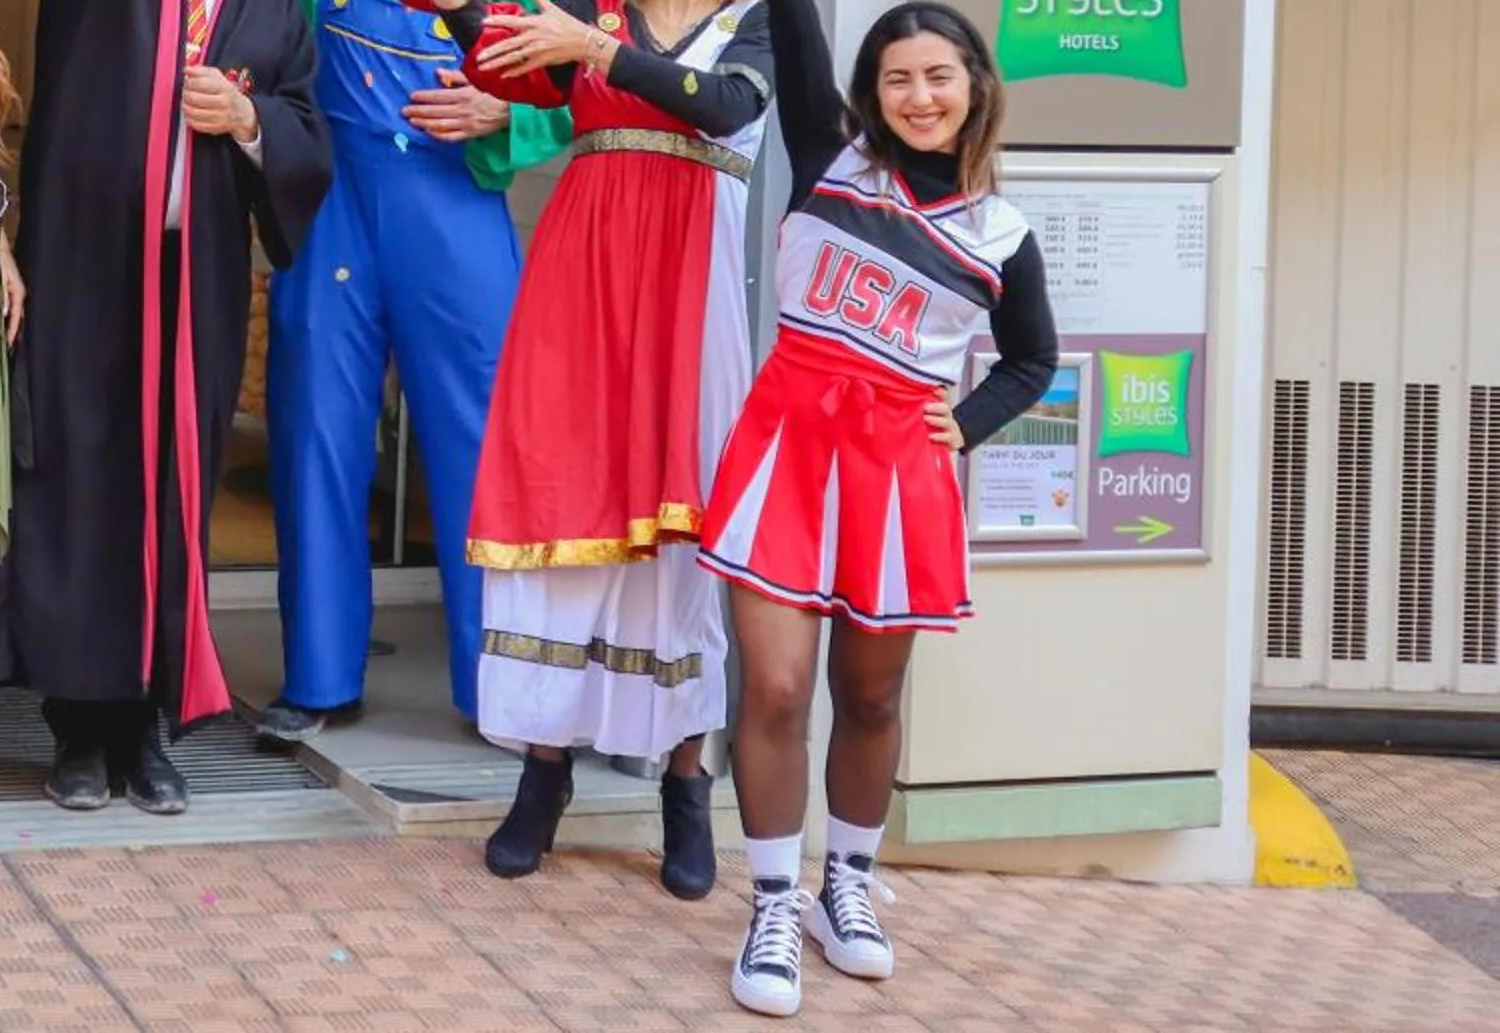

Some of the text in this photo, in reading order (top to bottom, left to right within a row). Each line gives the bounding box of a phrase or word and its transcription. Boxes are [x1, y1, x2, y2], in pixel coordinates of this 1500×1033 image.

[1059, 34, 1120, 50] HOTELS
[804, 240, 932, 359] USA
[1121, 374, 1171, 404] ibis
[1097, 464, 1192, 503] Parking
